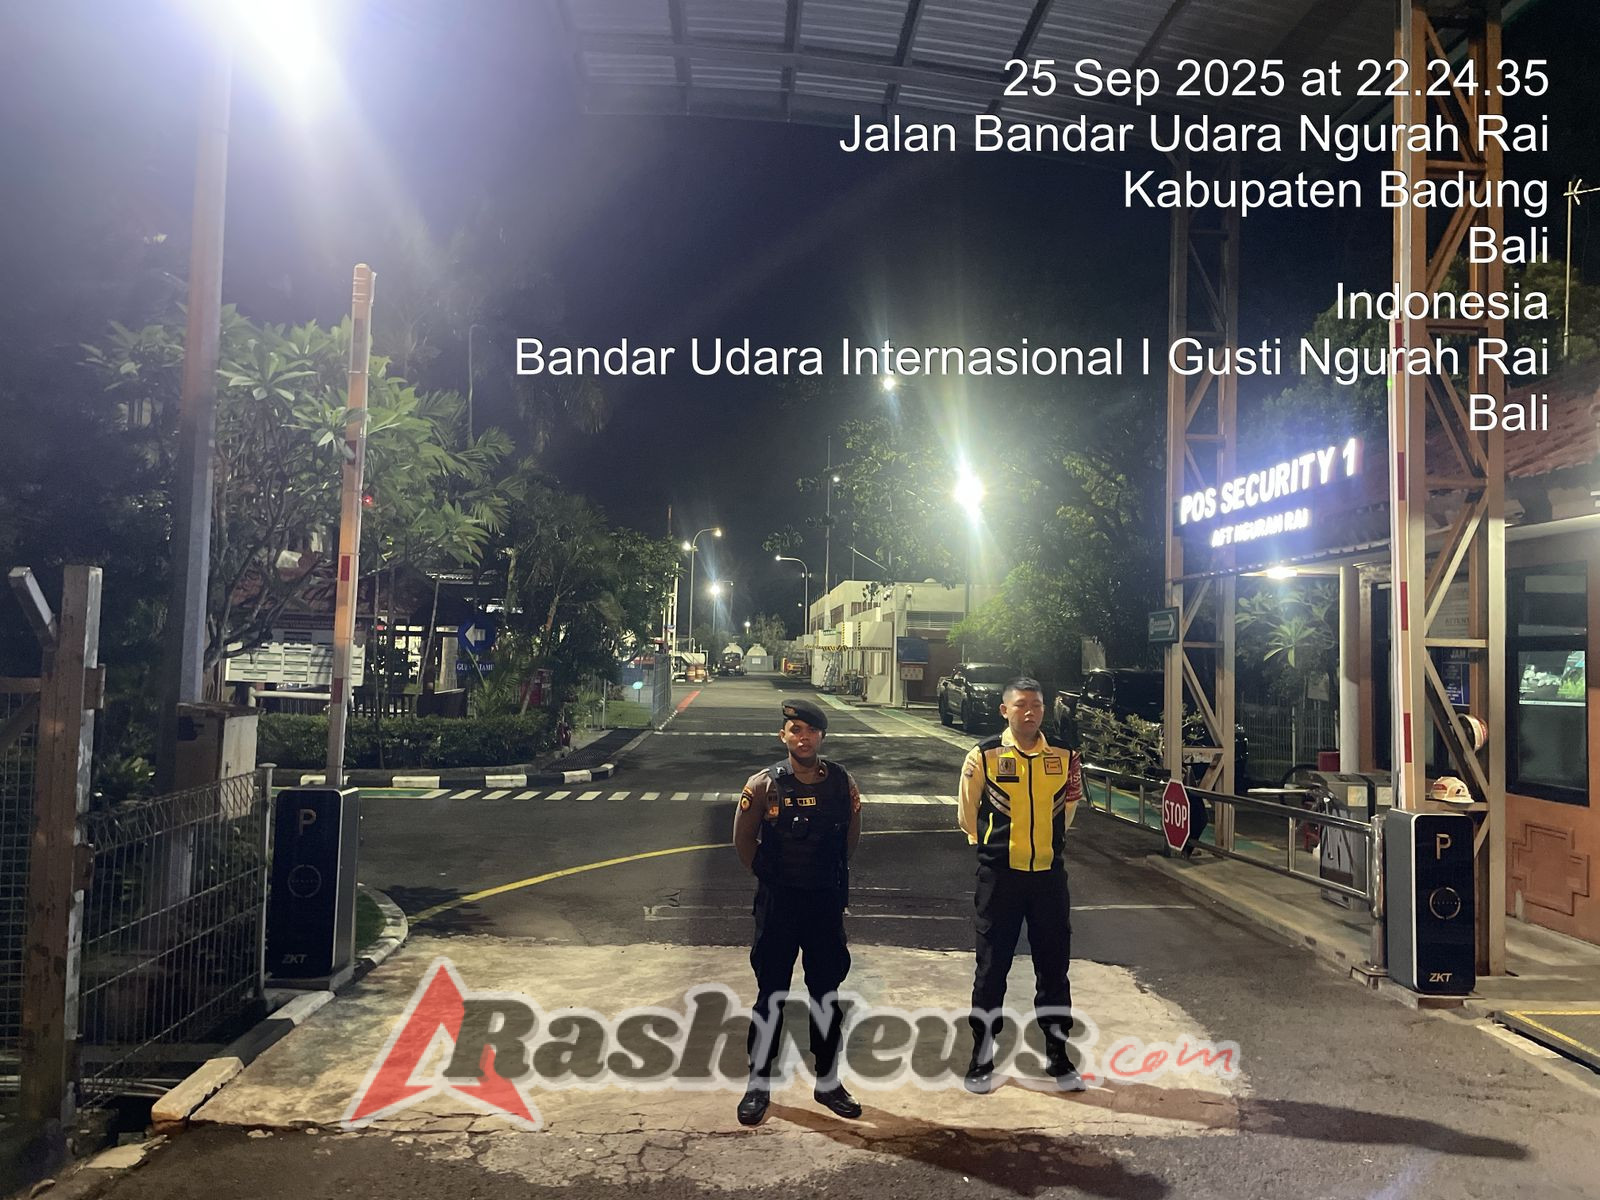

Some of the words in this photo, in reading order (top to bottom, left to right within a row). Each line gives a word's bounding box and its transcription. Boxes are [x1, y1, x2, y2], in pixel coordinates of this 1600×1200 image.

[1180, 487, 1217, 525] POS
[1221, 446, 1335, 514] SECURITY
[1342, 438, 1357, 476] 1
[298, 808, 317, 835] P
[1164, 799, 1188, 829] STOP
[1436, 833, 1452, 860] P
[1429, 972, 1453, 982] ZKT
